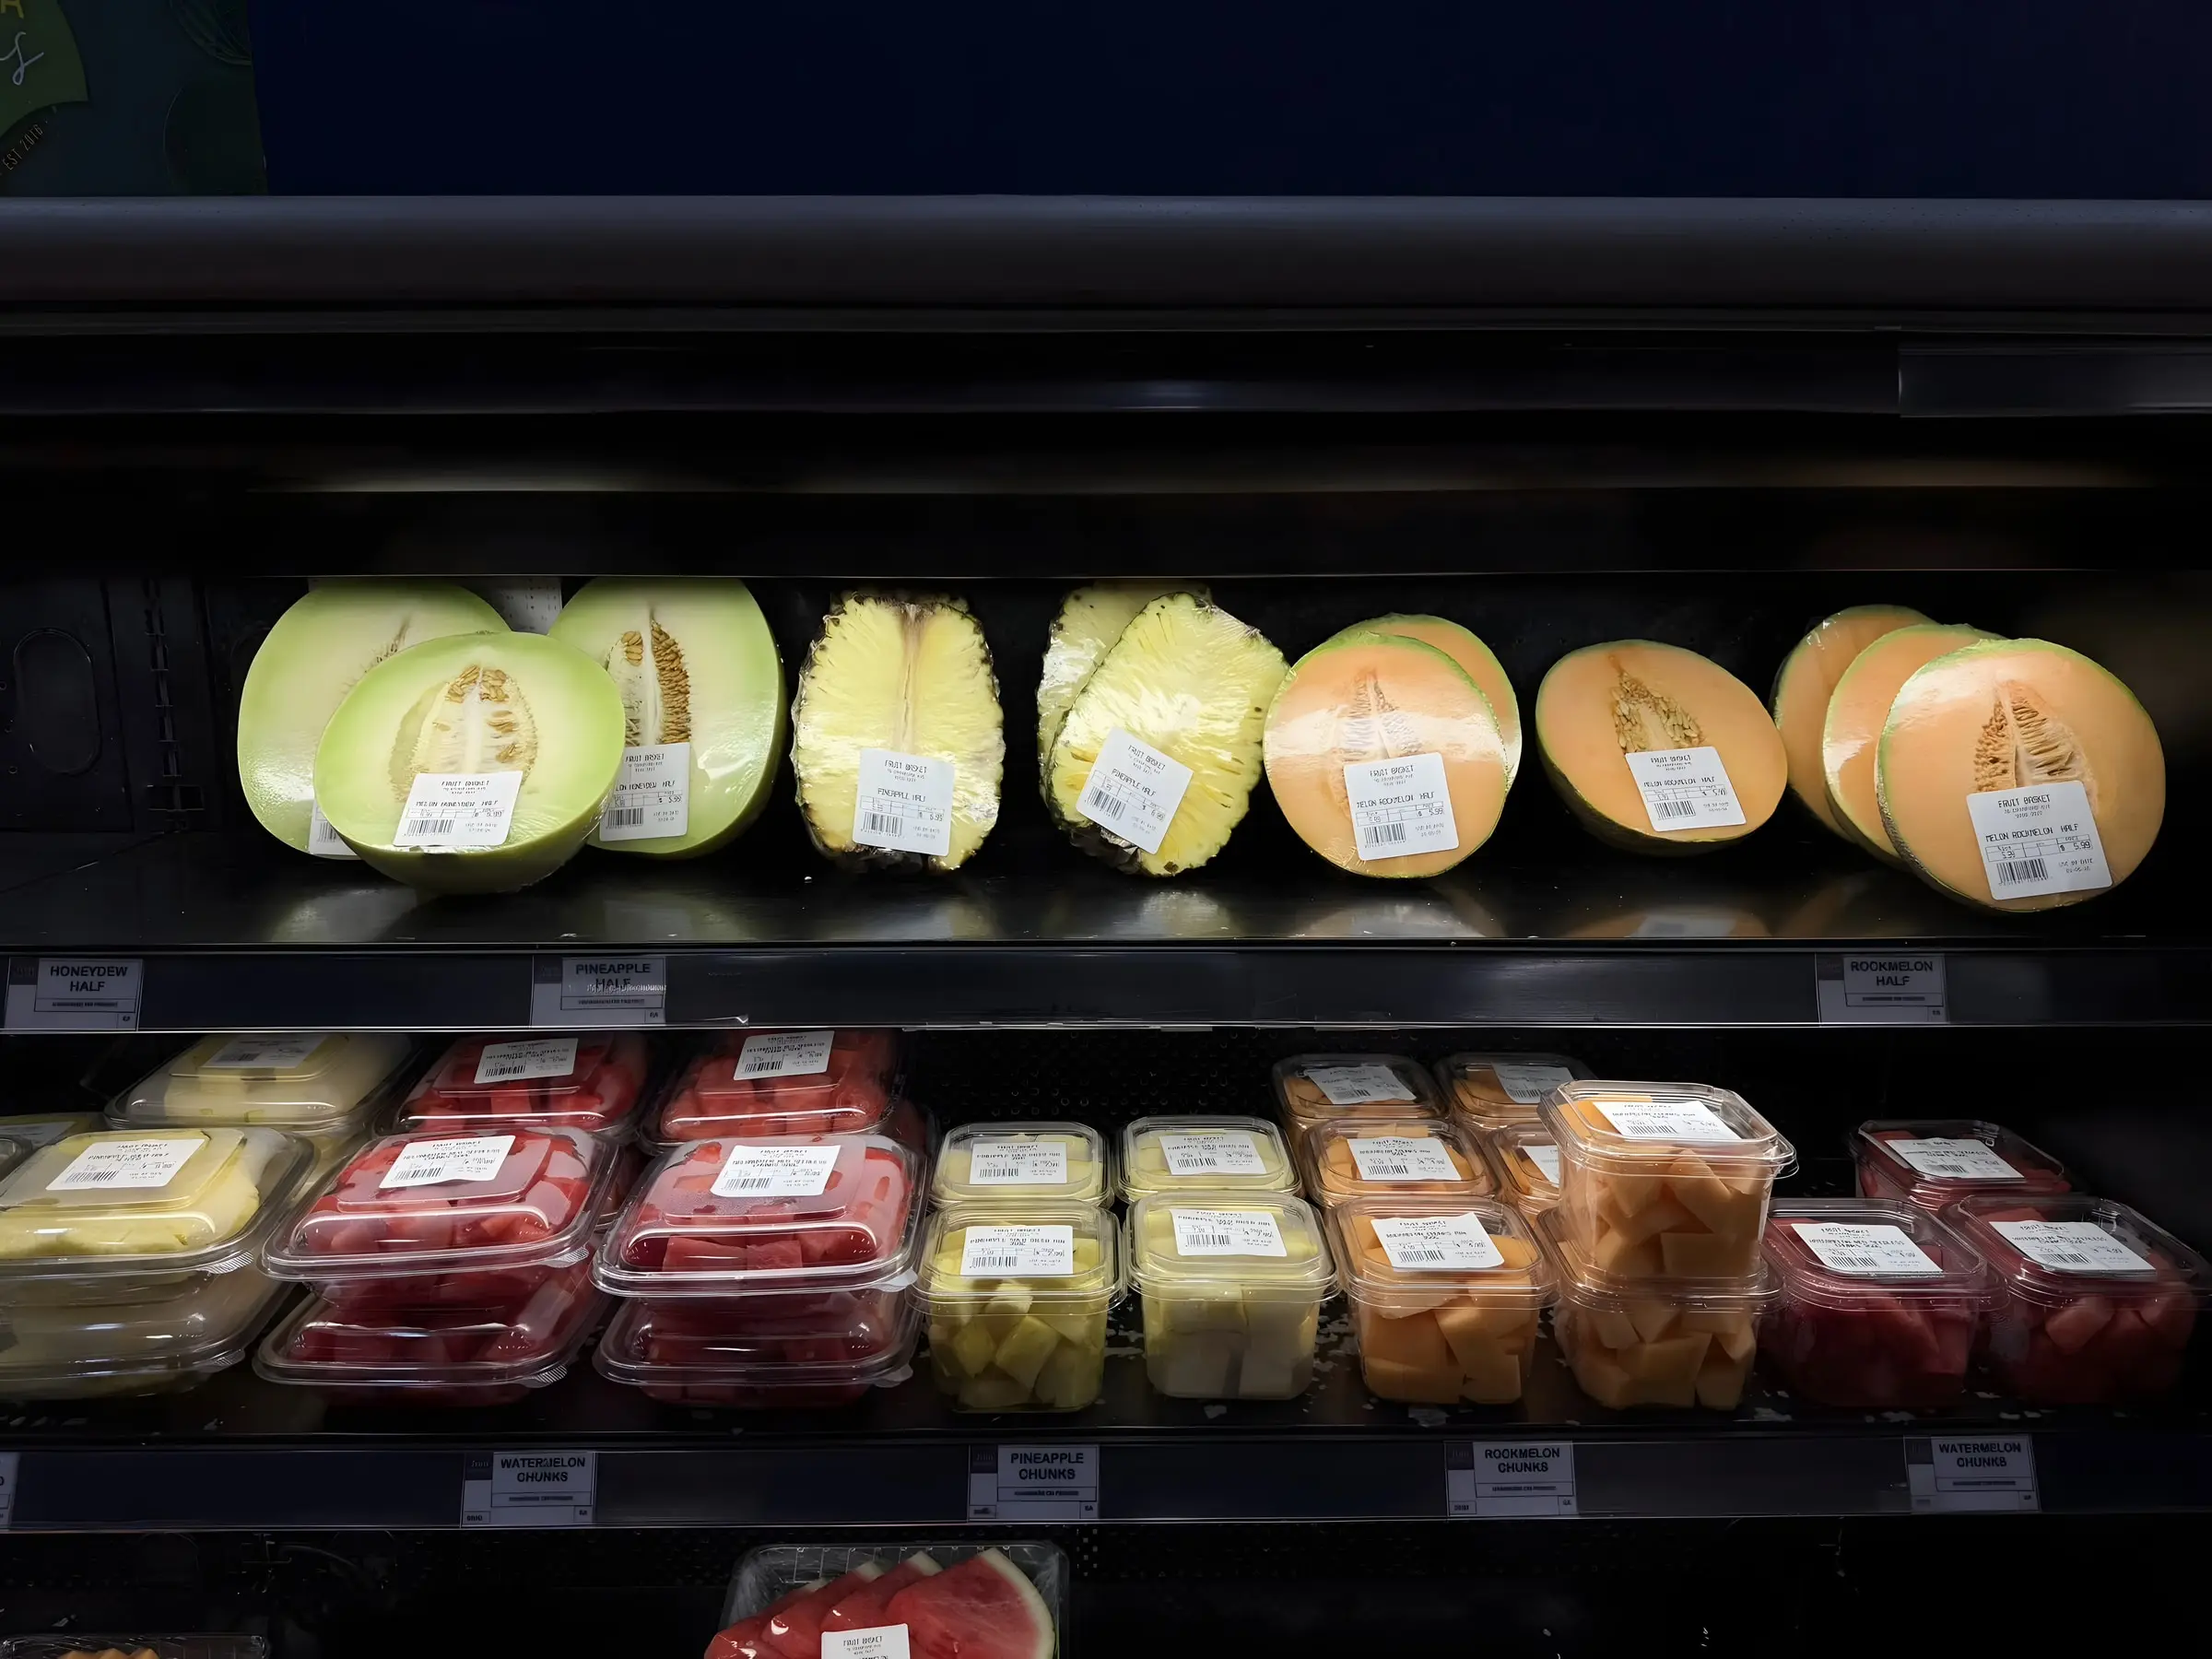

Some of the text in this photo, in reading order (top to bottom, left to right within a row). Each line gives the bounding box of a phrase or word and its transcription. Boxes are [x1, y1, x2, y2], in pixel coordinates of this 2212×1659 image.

[1997, 797, 2020, 808] FRUIT
[1985, 831, 2009, 843] MELON
[2060, 823, 2078, 834] HALF
[2073, 841, 2091, 852] 5.99
[50, 965, 129, 978] HONEYDEW
[575, 963, 653, 975] PINEAPPLE
[69, 981, 106, 993] HALF
[1876, 975, 1911, 988] HALF
[1938, 1442, 2022, 1454] WATERMELON
[500, 1456, 586, 1469] WATERMELON
[1010, 1453, 1084, 1465] PINEAPPLE
[1957, 1456, 2007, 1468] CHUNKS
[1018, 1468, 1076, 1480] CHUNKS
[1498, 1462, 1548, 1474] CHUNKS
[516, 1471, 568, 1483] CHUNKS
